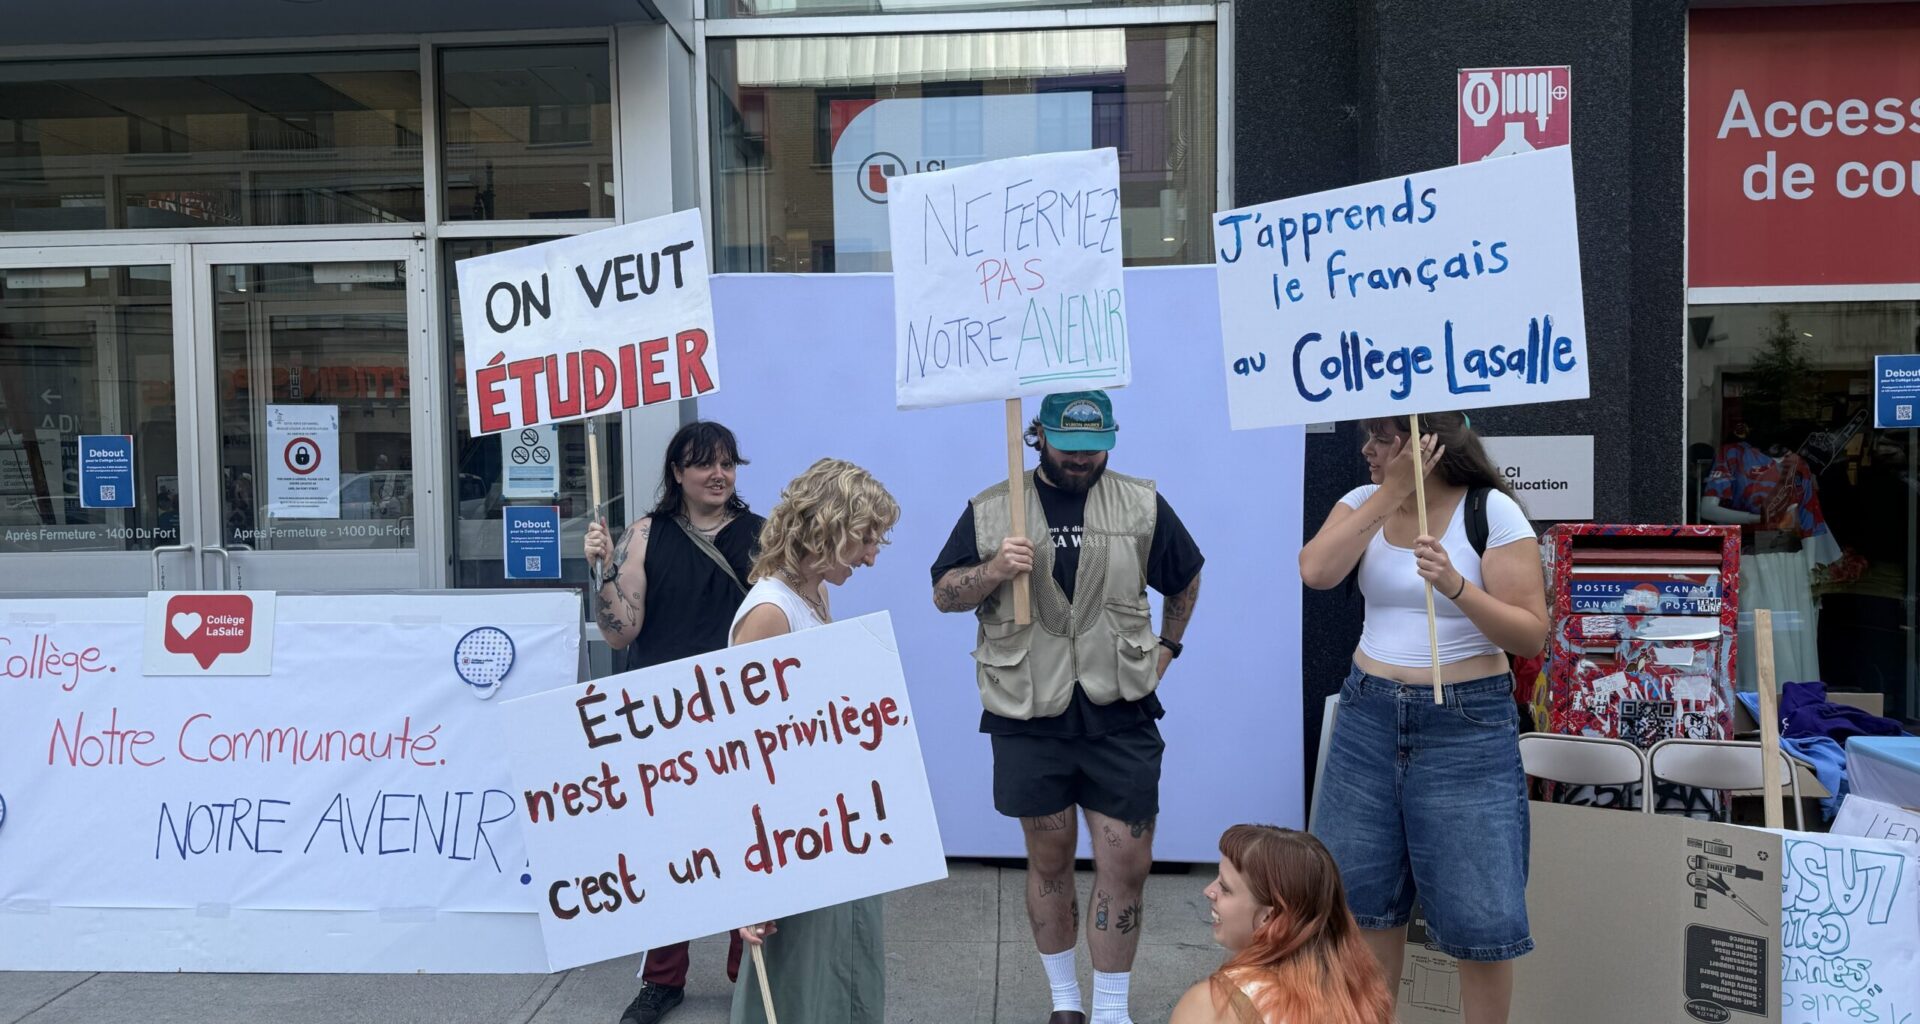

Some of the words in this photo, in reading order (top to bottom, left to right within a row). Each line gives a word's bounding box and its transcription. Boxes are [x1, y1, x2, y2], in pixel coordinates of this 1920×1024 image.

[1743, 150, 1815, 200] de
[1836, 160, 1920, 198] co
[924, 184, 992, 265] NE
[1003, 178, 1120, 254] FERMEZ
[1218, 177, 1436, 267] J'apprends
[976, 258, 1045, 304] PAS
[1273, 273, 1304, 310] le
[1326, 240, 1509, 300] français
[485, 272, 552, 334] ON
[575, 240, 694, 309] VEUT
[906, 315, 1008, 384] NOTRE
[1233, 351, 1266, 376] au
[1292, 330, 1434, 402] Collège
[1444, 314, 1577, 395] Lasalle
[476, 328, 715, 434] ÉTUDIER
[89, 449, 124, 458] Debout
[1504, 479, 1568, 490] ducation
[514, 520, 550, 528] Debout
[5, 529, 37, 542] Après
[40, 528, 96, 540] Fermeture
[106, 528, 133, 540] 1400
[136, 528, 150, 539] Du
[153, 528, 176, 539] Fort
[234, 528, 267, 540] Après
[270, 526, 327, 538] Fermeture
[338, 525, 365, 537] 1400
[368, 525, 383, 537] Du
[386, 525, 410, 536] Fort
[1576, 584, 1621, 592] POSTES
[1665, 585, 1714, 593] CANADA
[206, 615, 245, 626] Collège
[206, 627, 244, 636] LaSalle
[575, 656, 801, 749] Étudier
[48, 708, 166, 768] Notre
[178, 714, 446, 767] Communauté.
[524, 762, 628, 824] n'est
[638, 750, 698, 817] pas
[704, 738, 750, 776] un
[754, 696, 909, 786] privilège,
[156, 798, 291, 860] NOTRE
[548, 853, 646, 920] c'est
[668, 847, 721, 885] un
[744, 780, 894, 874] droit!
[1735, 944, 1757, 953] Carton
[1700, 968, 1719, 978] board
[1700, 983, 1730, 994] surfaced
[1721, 980, 1736, 989] duty
[1737, 982, 1757, 992] Heavy
[1712, 992, 1757, 1007] Self-standing
[1731, 990, 1757, 1000] Smooth
